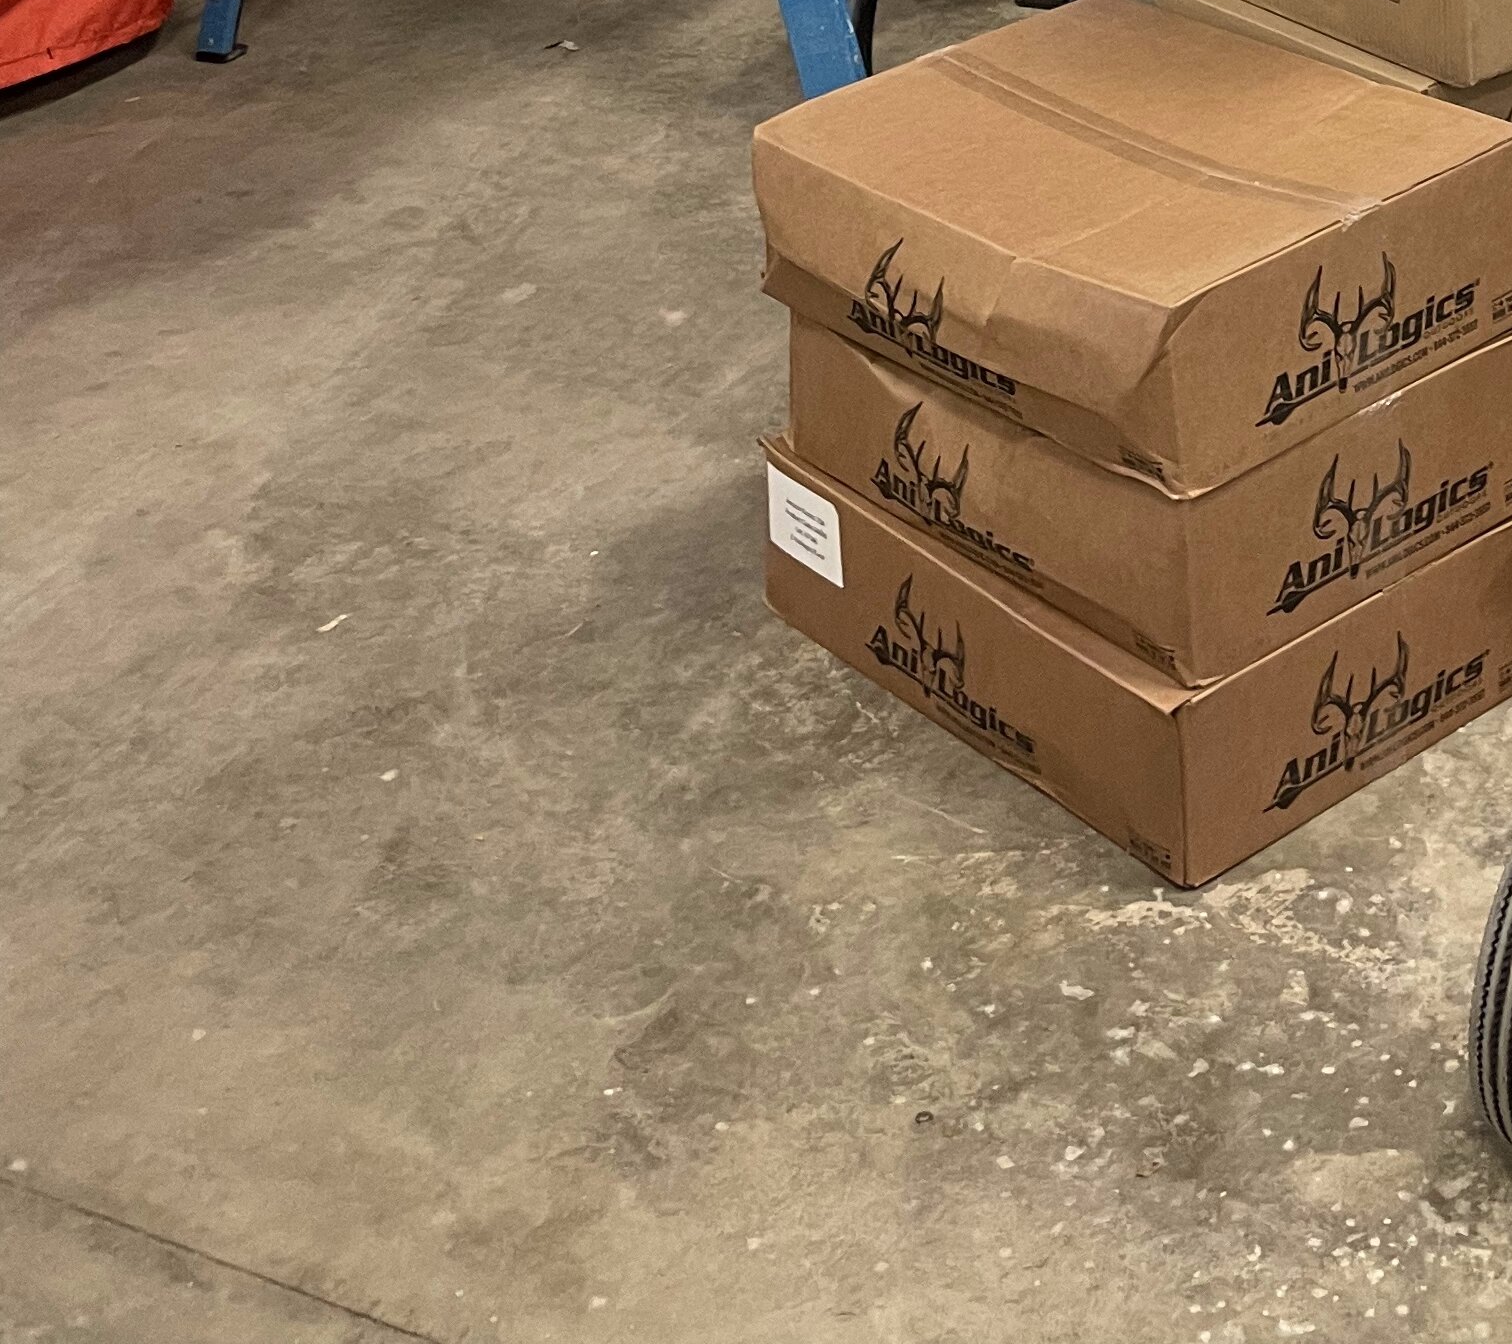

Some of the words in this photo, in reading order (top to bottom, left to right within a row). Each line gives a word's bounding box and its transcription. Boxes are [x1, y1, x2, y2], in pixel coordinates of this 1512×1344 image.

[1265, 349, 1333, 416] Ani
[1358, 281, 1477, 367] Logics
[1275, 536, 1345, 603] Ani
[1370, 464, 1489, 552] Logics
[1365, 653, 1486, 745] Logics
